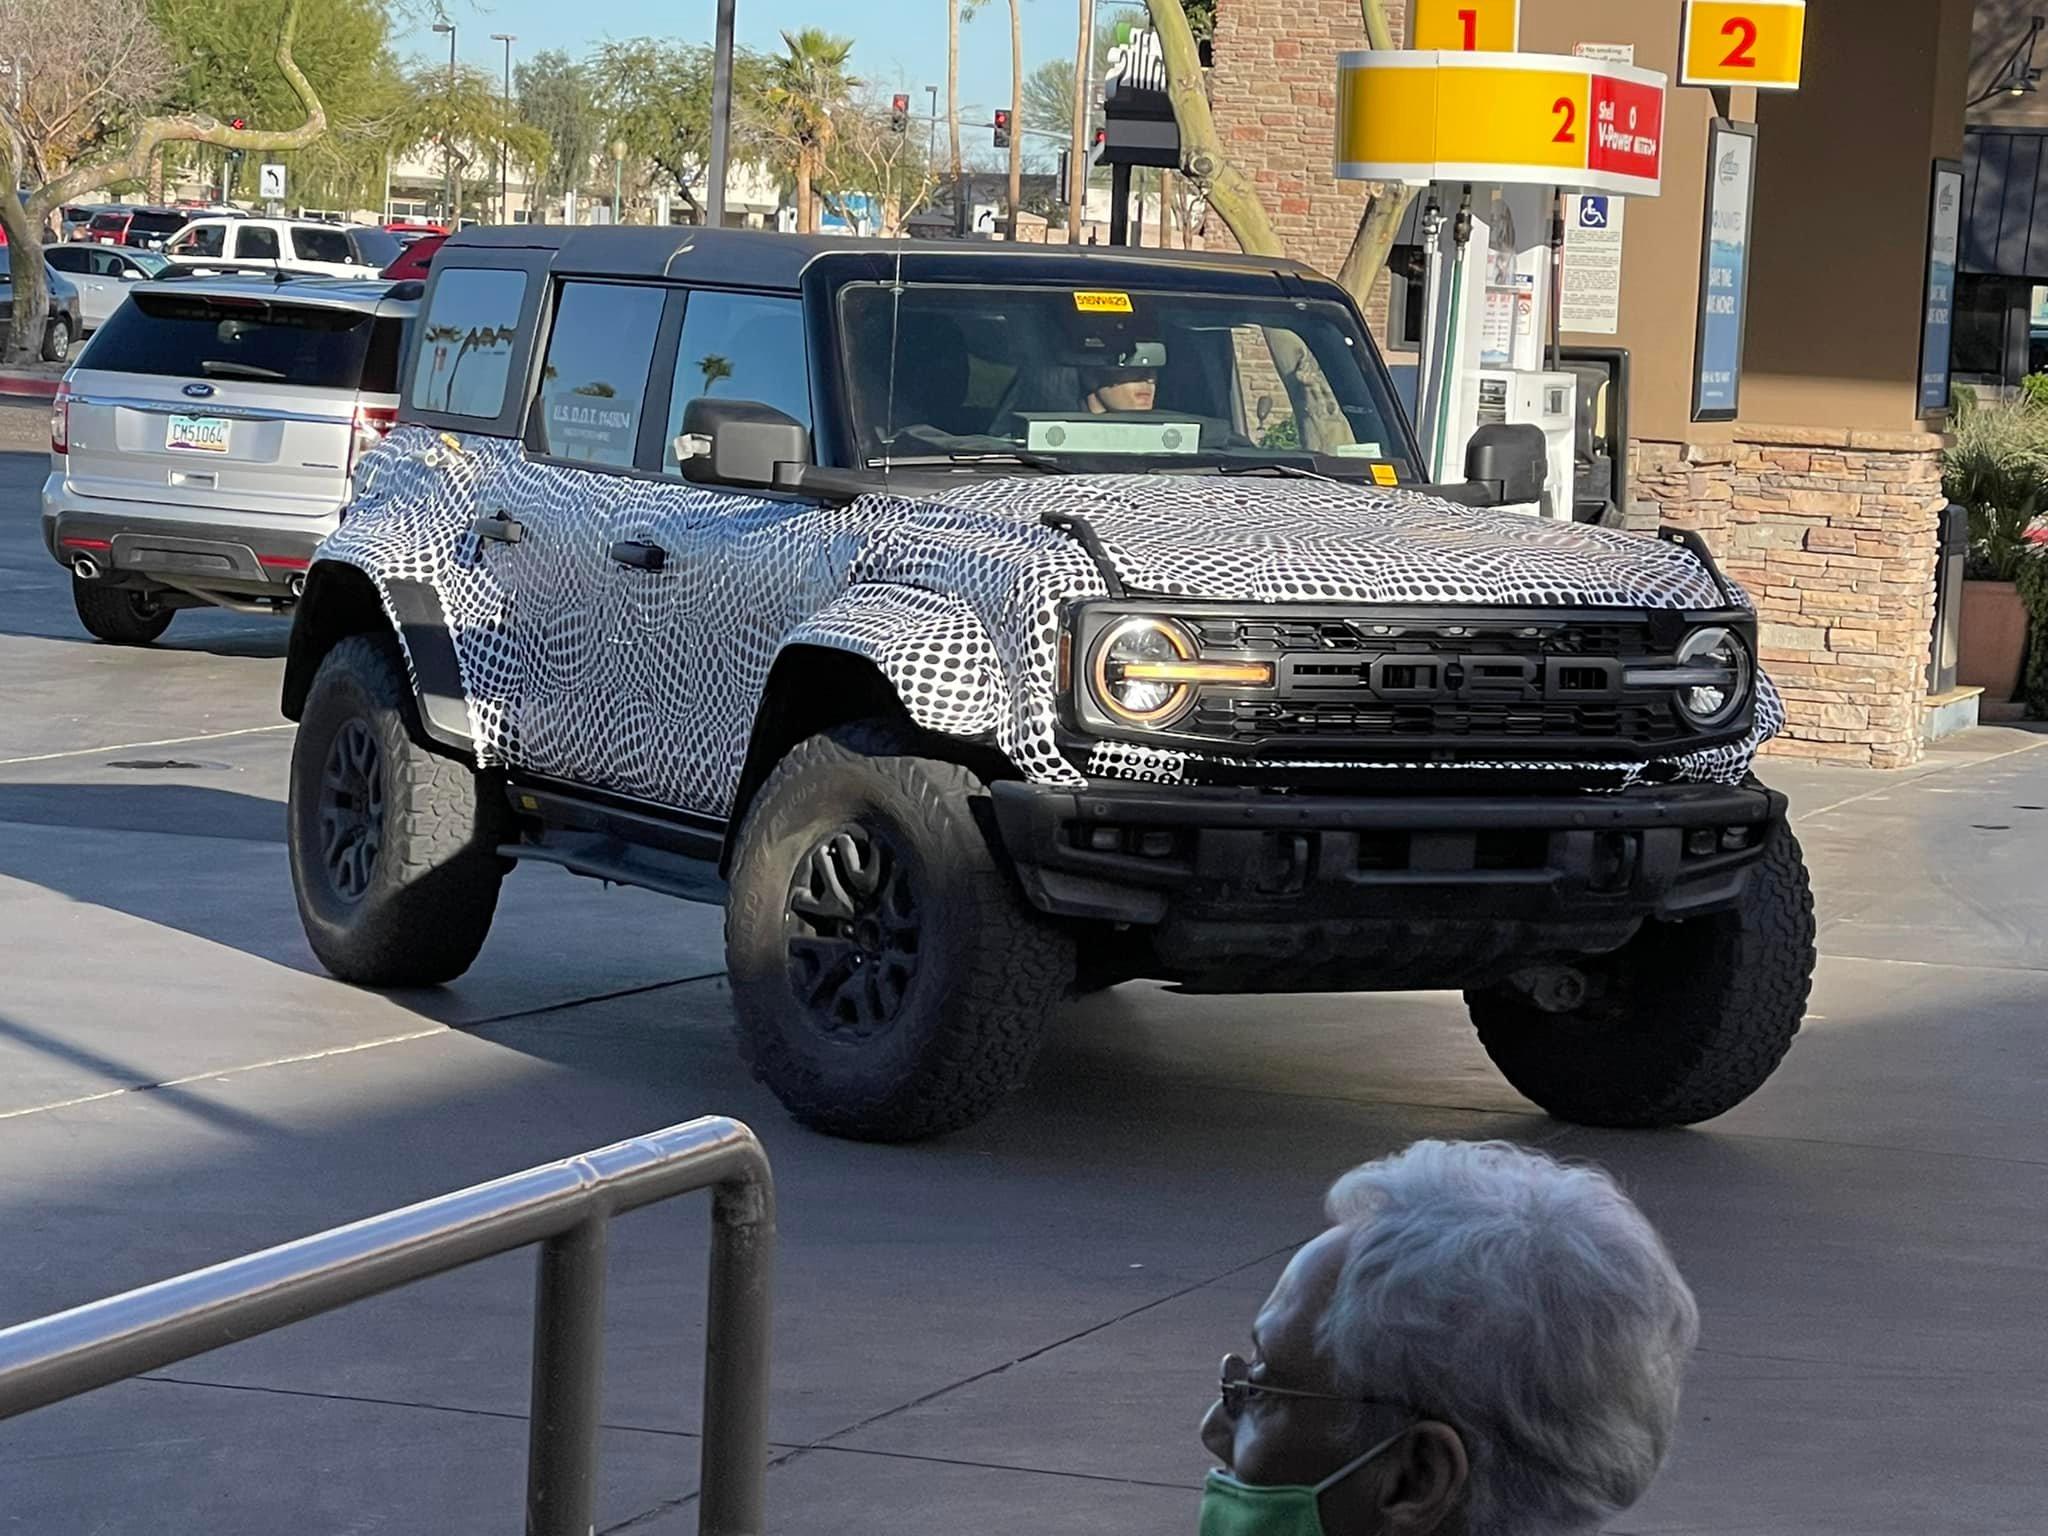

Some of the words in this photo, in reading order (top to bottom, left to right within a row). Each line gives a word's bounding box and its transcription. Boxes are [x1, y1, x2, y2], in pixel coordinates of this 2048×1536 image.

[1458, 9, 1477, 51] 1
[1719, 17, 1757, 67] 2
[1596, 47, 1622, 55] smoking
[1552, 97, 1575, 143] 2
[1598, 100, 1615, 121] Shell
[1598, 121, 1634, 153] V-Power
[173, 424, 222, 443] CM51064
[1280, 652, 1624, 701] FORD
